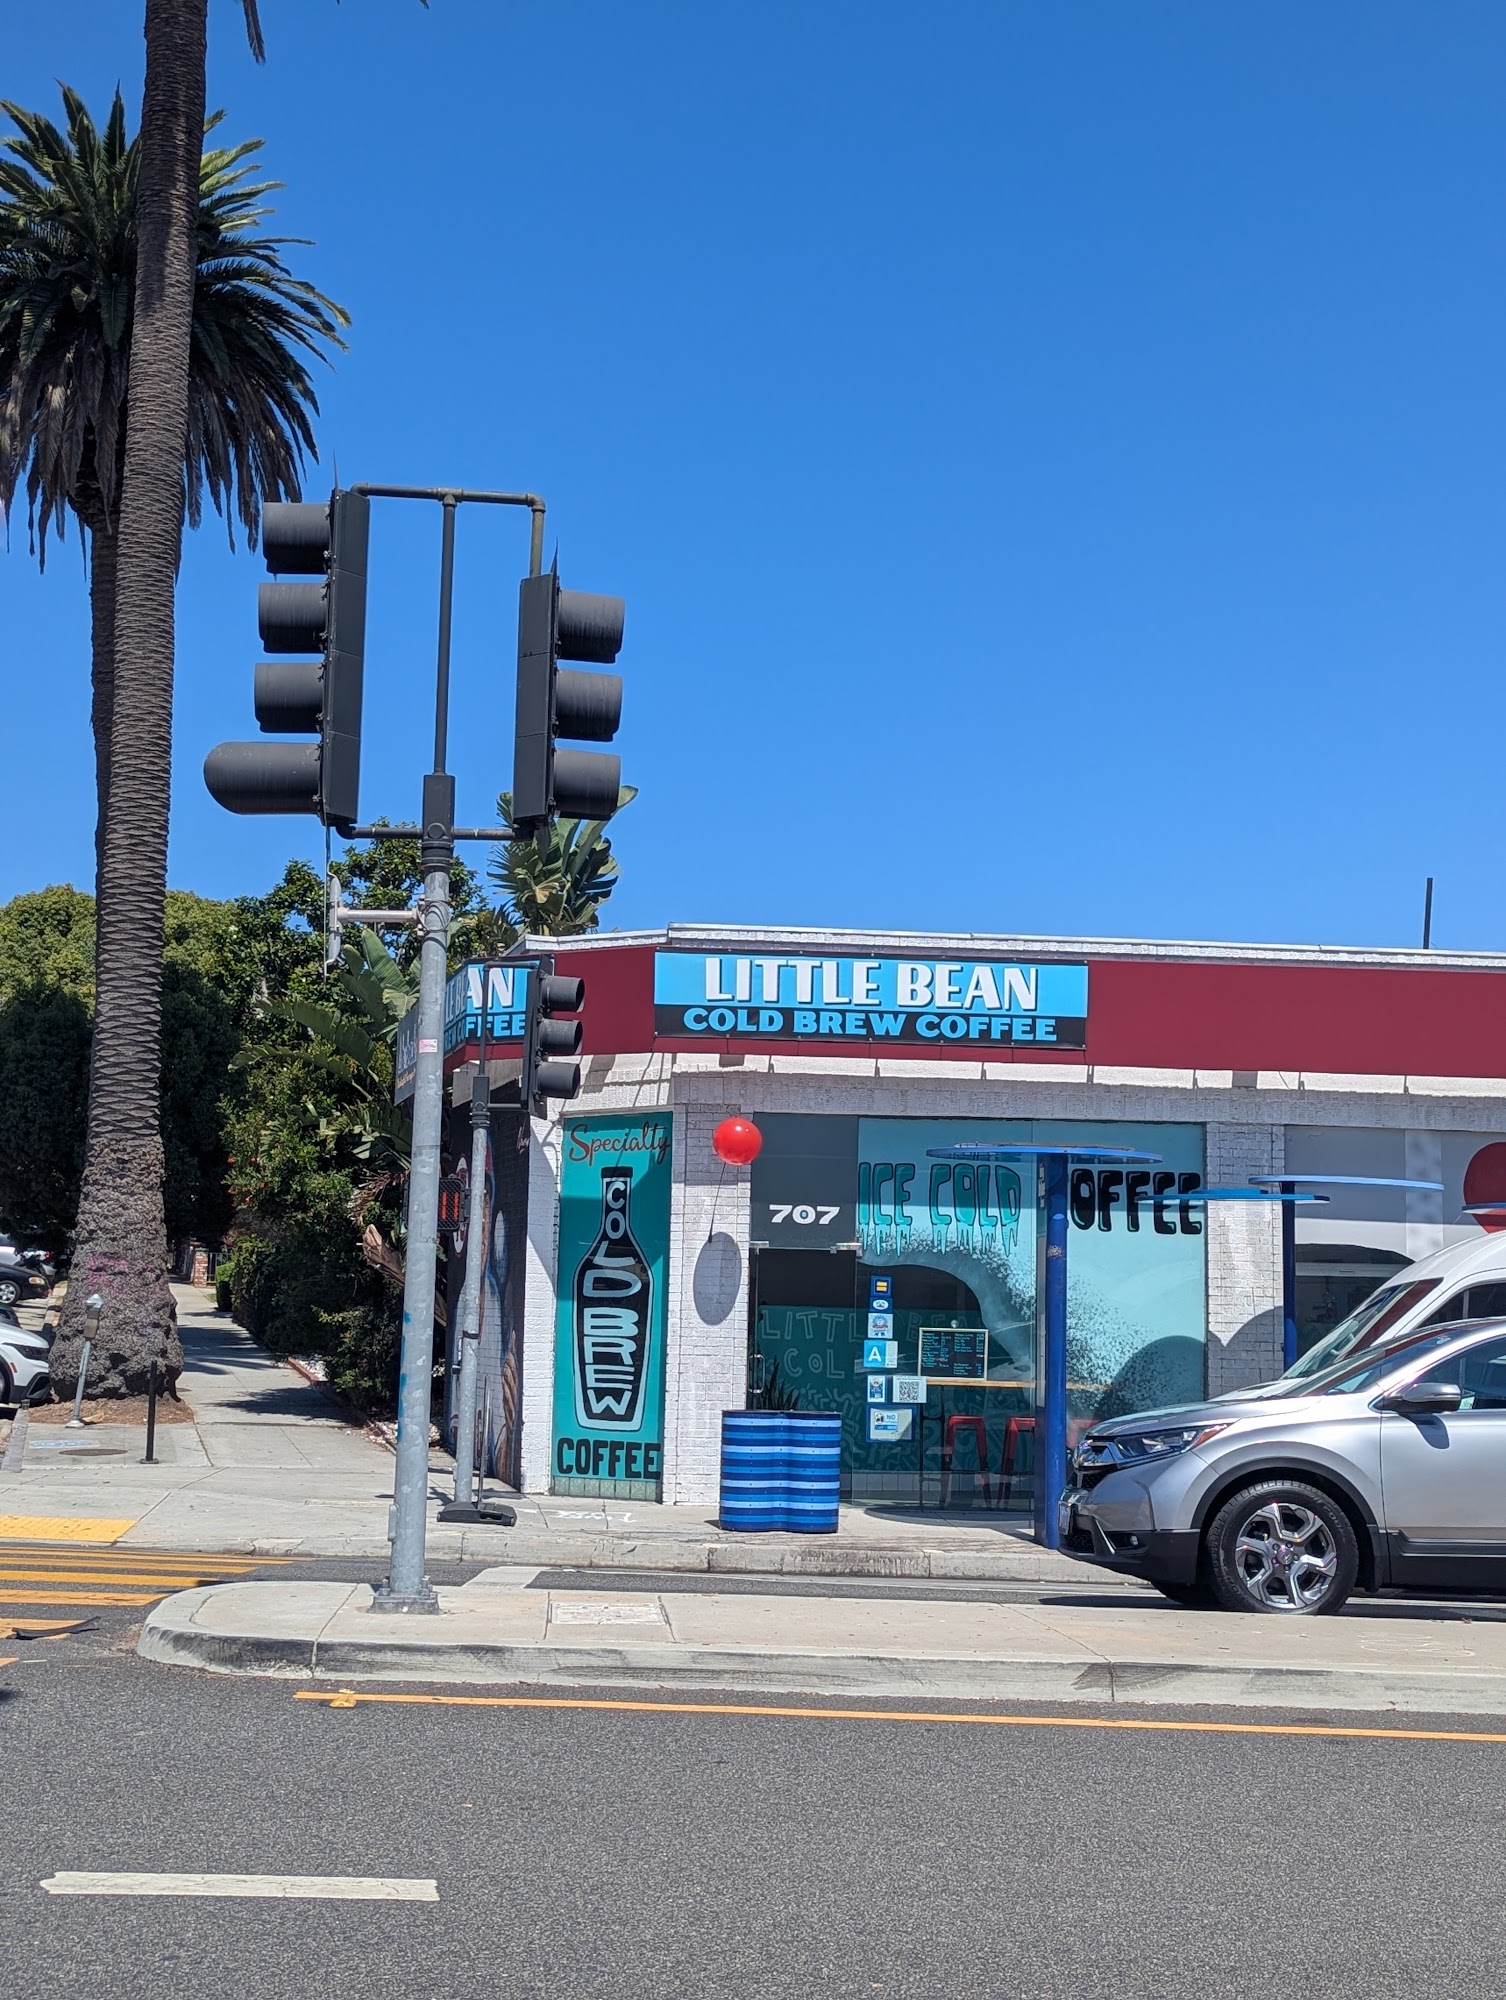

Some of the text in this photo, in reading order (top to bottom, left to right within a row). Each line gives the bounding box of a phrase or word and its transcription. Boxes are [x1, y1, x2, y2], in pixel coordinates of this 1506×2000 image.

[704, 957, 1038, 1011] LITTLE BEAN
[683, 1007, 1058, 1042] COLD BREW COFFEE
[569, 1121, 671, 1166] Specialty
[769, 1204, 841, 1226] 707
[858, 1162, 1022, 1257] ICE COLD
[1070, 1168, 1203, 1235] OFFEE
[582, 1180, 643, 1299] COLD
[761, 1309, 866, 1343] LITTL
[582, 1306, 641, 1416] BREW
[783, 1347, 846, 1379] COL
[868, 1346, 882, 1362] A
[556, 1437, 662, 1480] COFFEE
